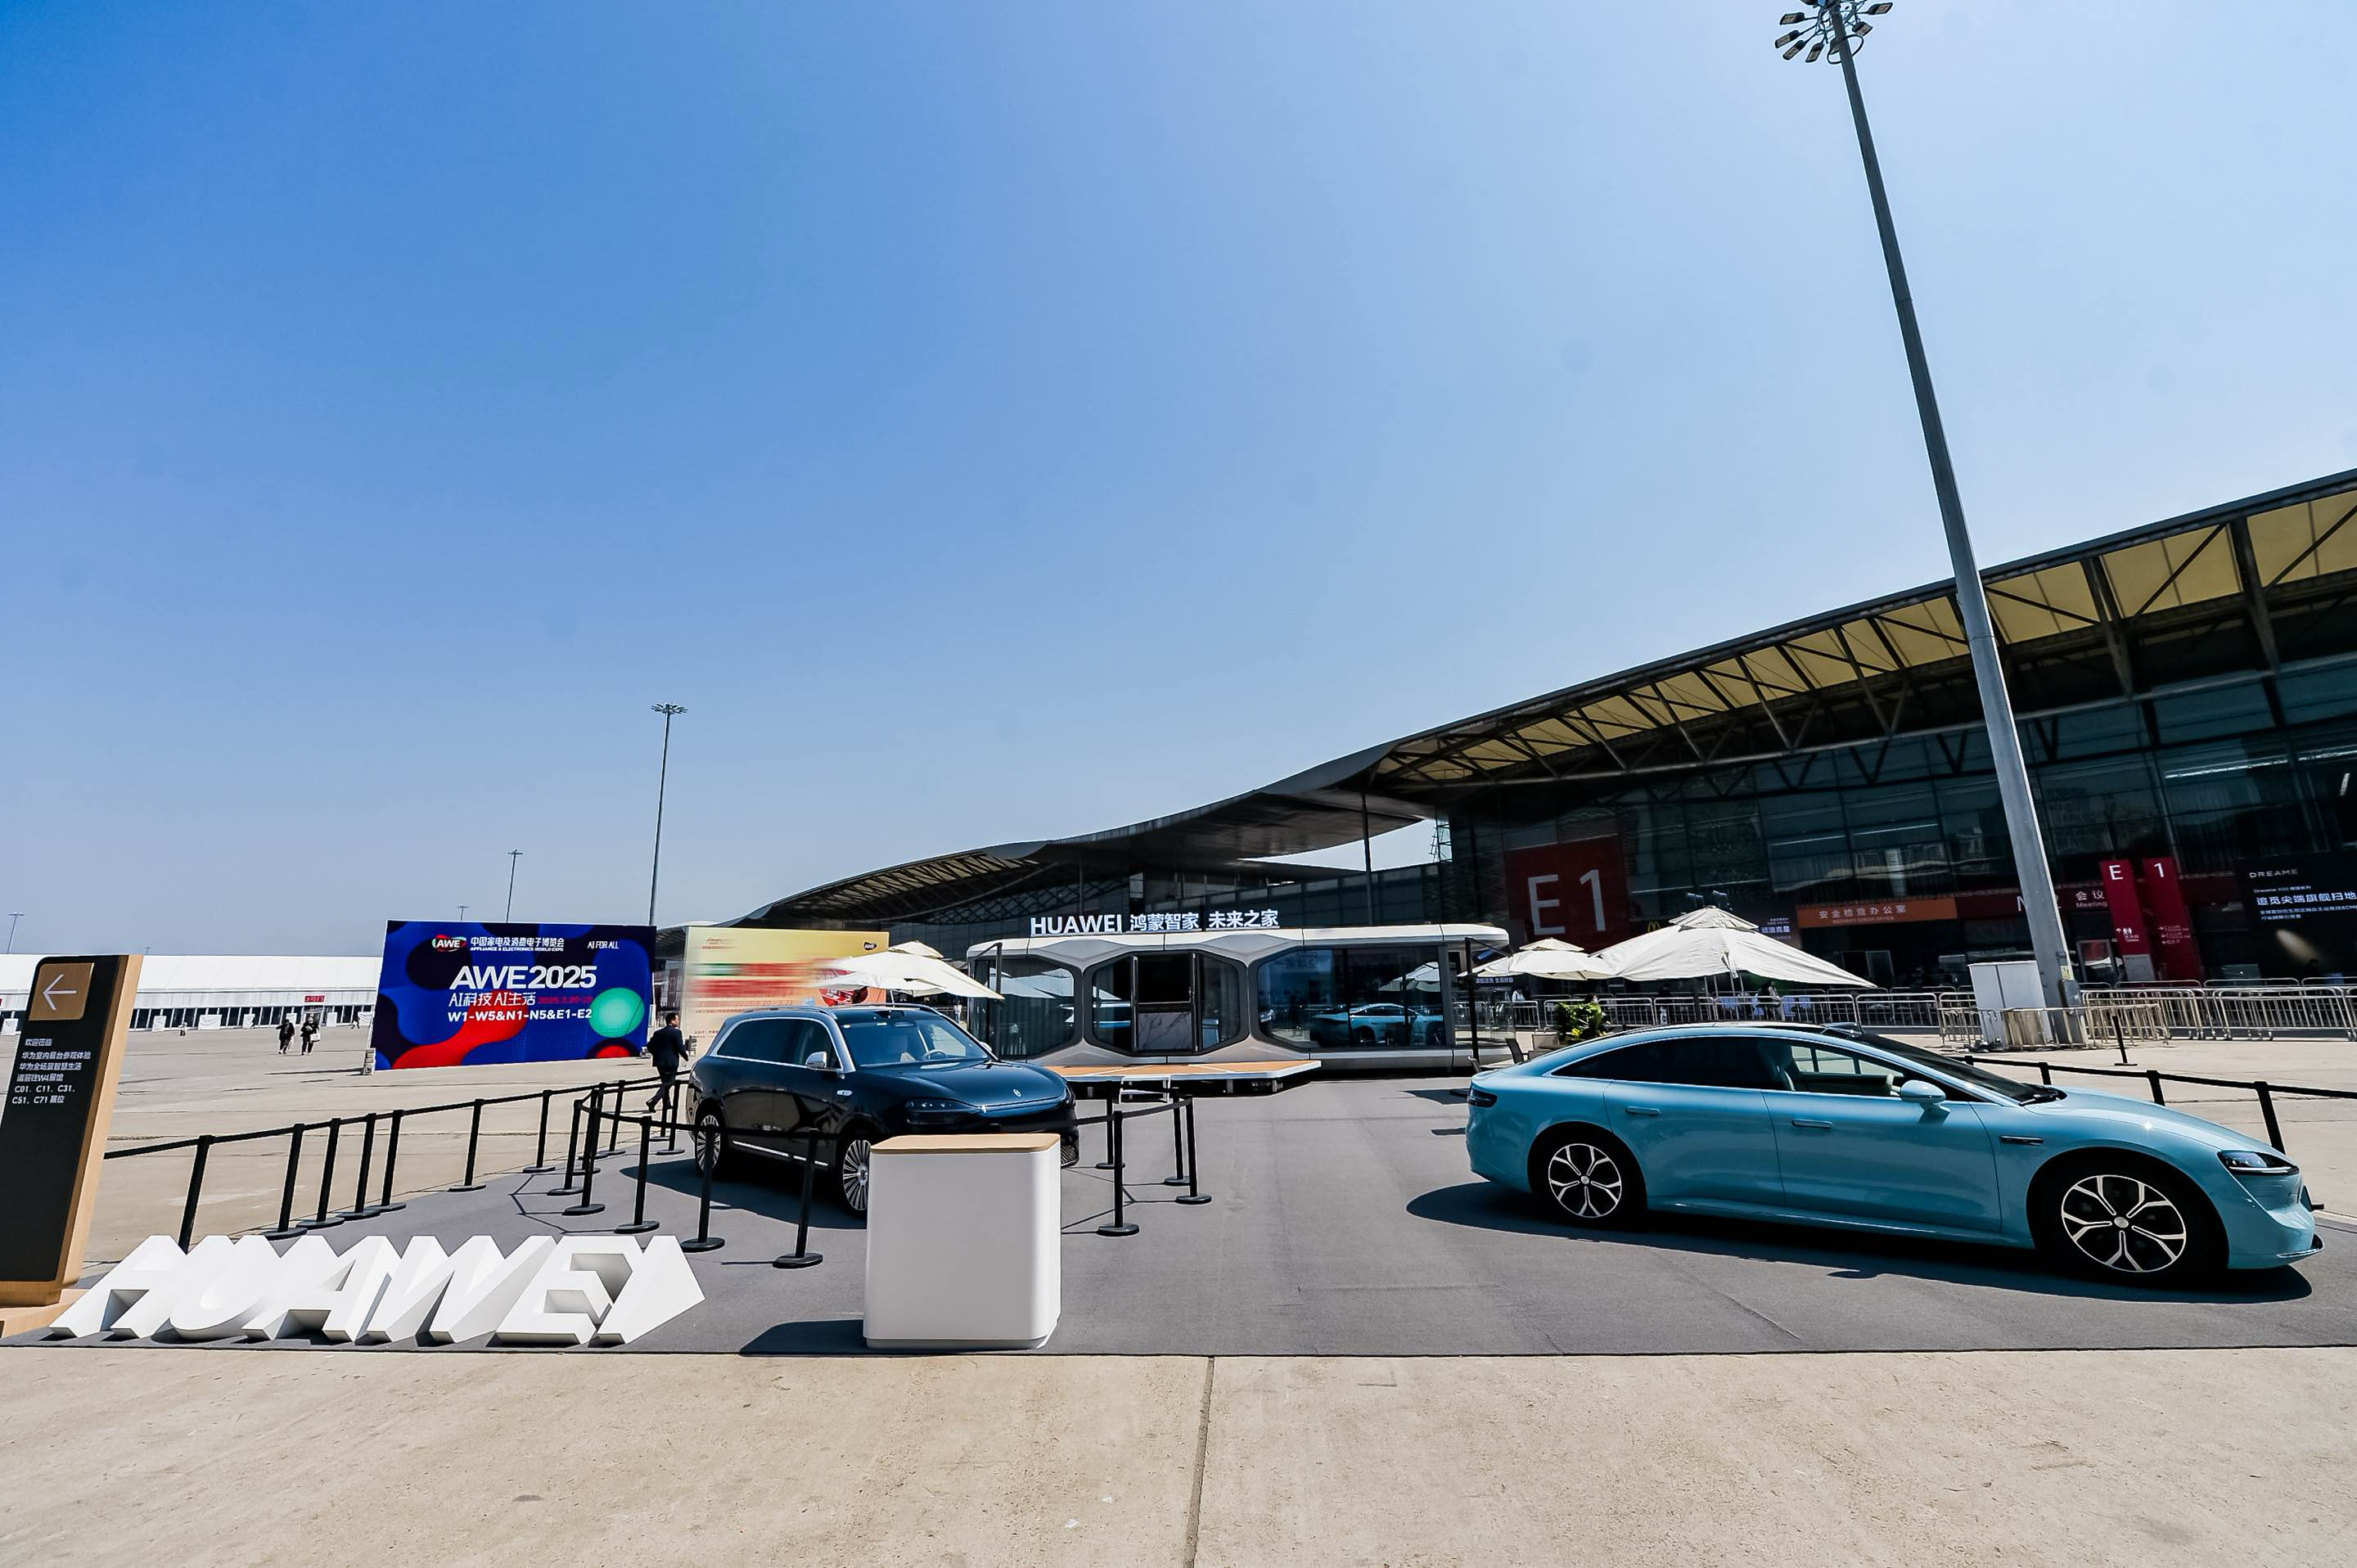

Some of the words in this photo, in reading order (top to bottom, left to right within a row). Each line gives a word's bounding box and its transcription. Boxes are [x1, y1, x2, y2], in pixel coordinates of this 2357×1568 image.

[2249, 868, 2299, 878] DREAME
[1528, 869, 1606, 935] E1
[1818, 903, 1907, 920] 安全检查办公室
[1030, 913, 1124, 935] HUAWEI
[1129, 912, 1200, 932] 鸿蒙智家
[1207, 908, 1280, 930] 未来之家
[436, 939, 461, 948] AWE
[471, 936, 565, 948] 中国家电及消费电子博览会
[587, 940, 595, 949] AI
[595, 940, 608, 949] FOR
[608, 940, 620, 949] ALL
[449, 966, 597, 989] AWE2025
[448, 992, 493, 1007] AI科技
[493, 991, 537, 1007] AI生活
[448, 1007, 593, 1022] W1-W5&N1-N5&E1-E2
[49, 1235, 705, 1345] HUAWEI
